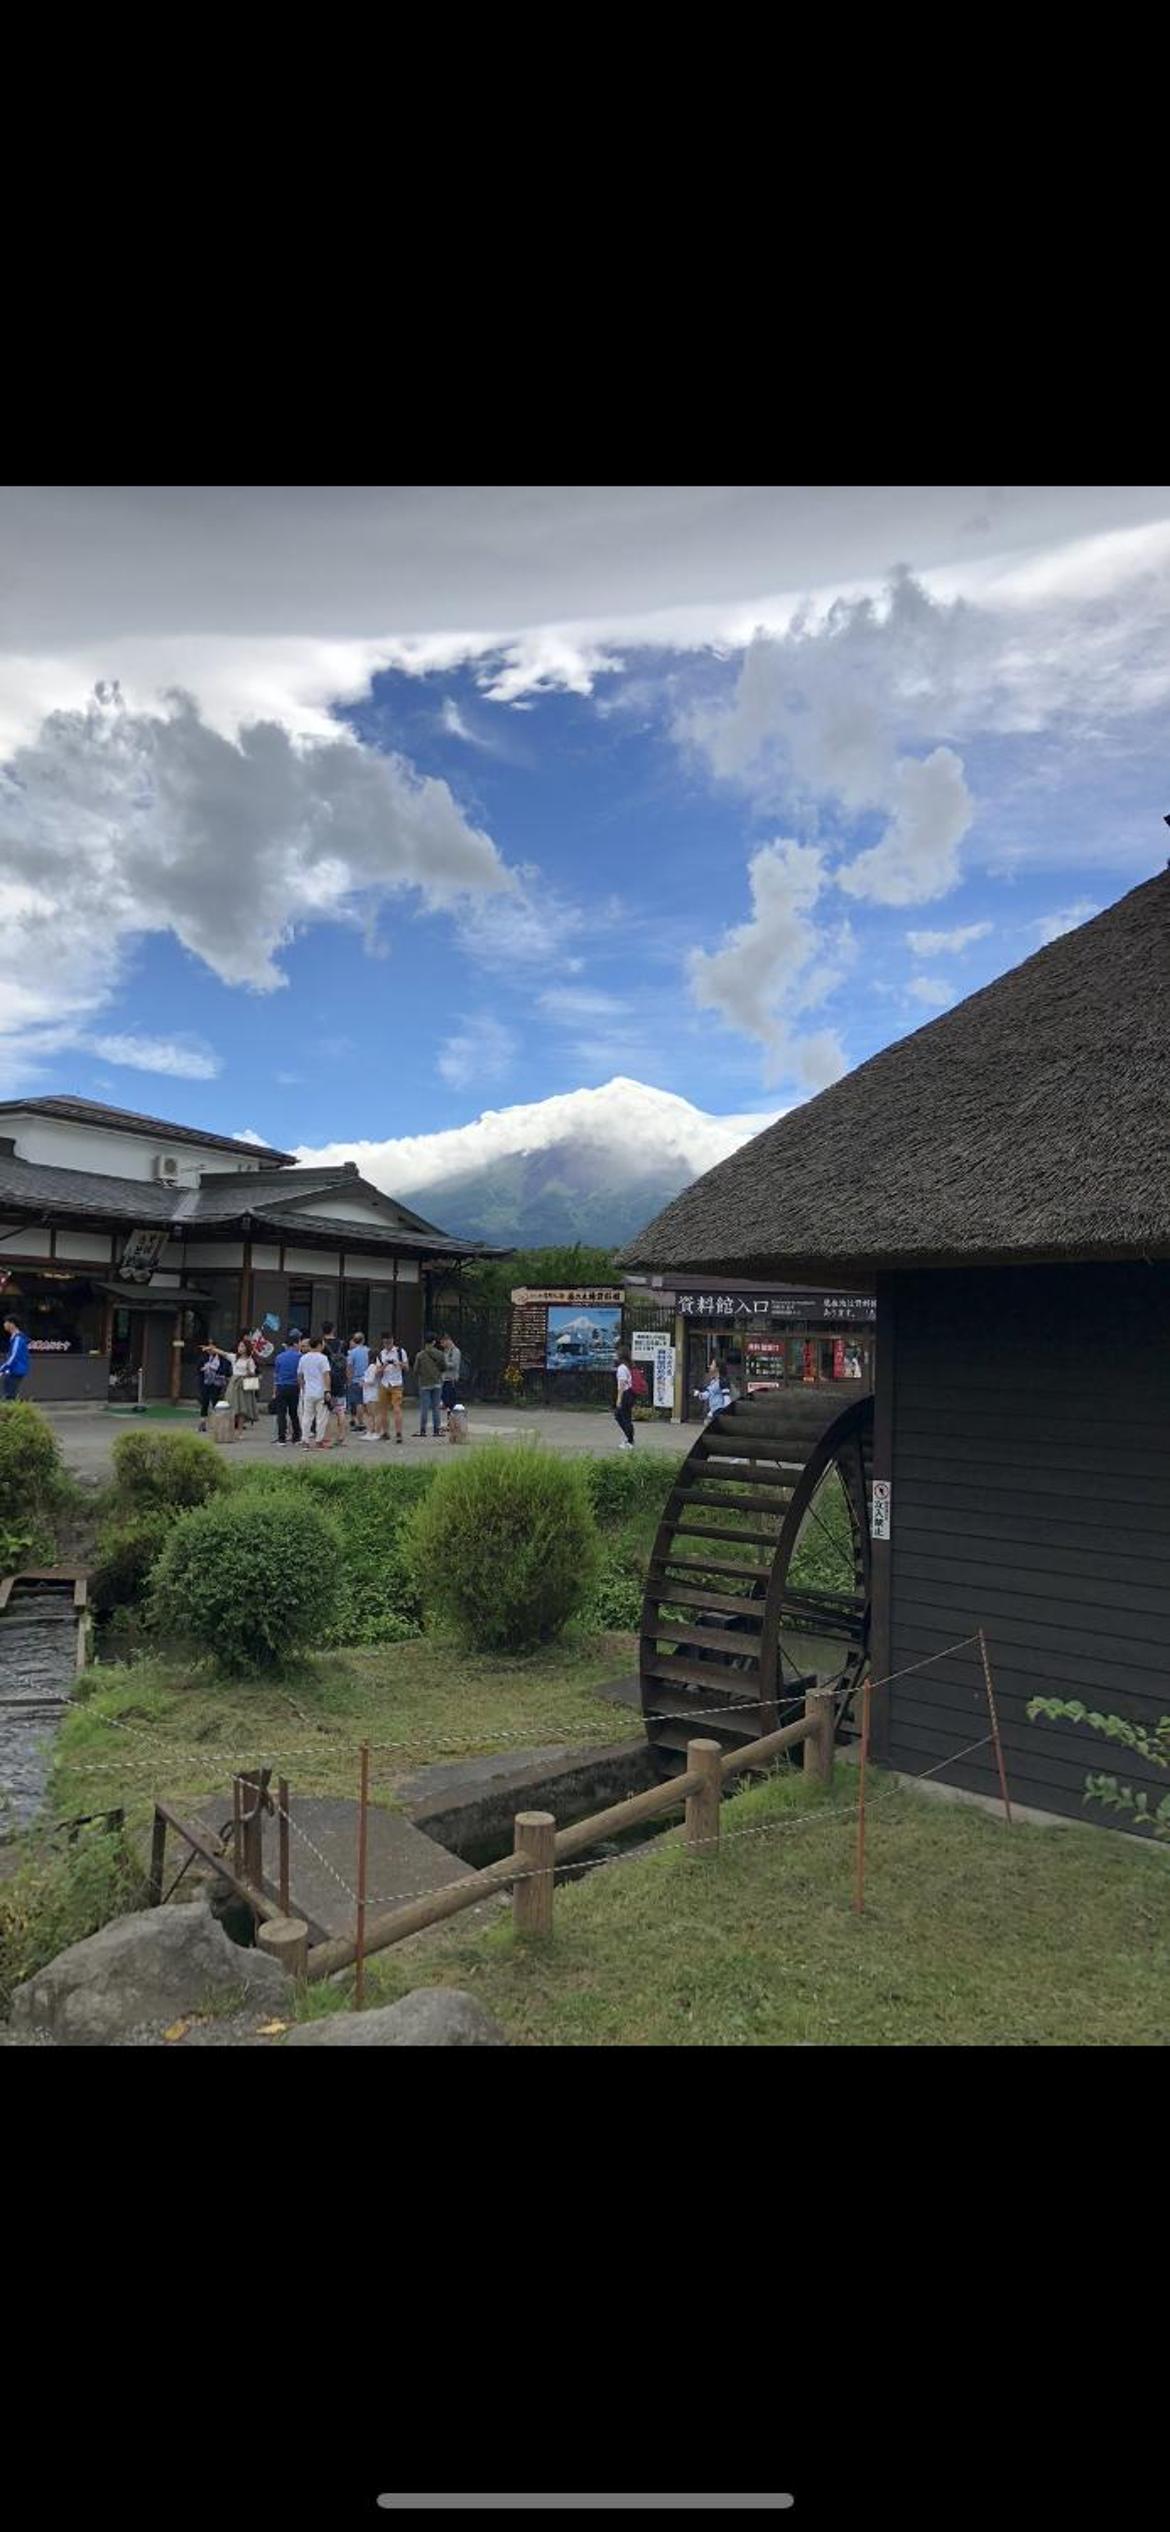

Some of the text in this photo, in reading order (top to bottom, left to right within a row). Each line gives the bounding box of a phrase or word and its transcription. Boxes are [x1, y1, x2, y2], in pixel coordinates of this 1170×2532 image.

[678, 1295, 769, 1314] 資料館入口
